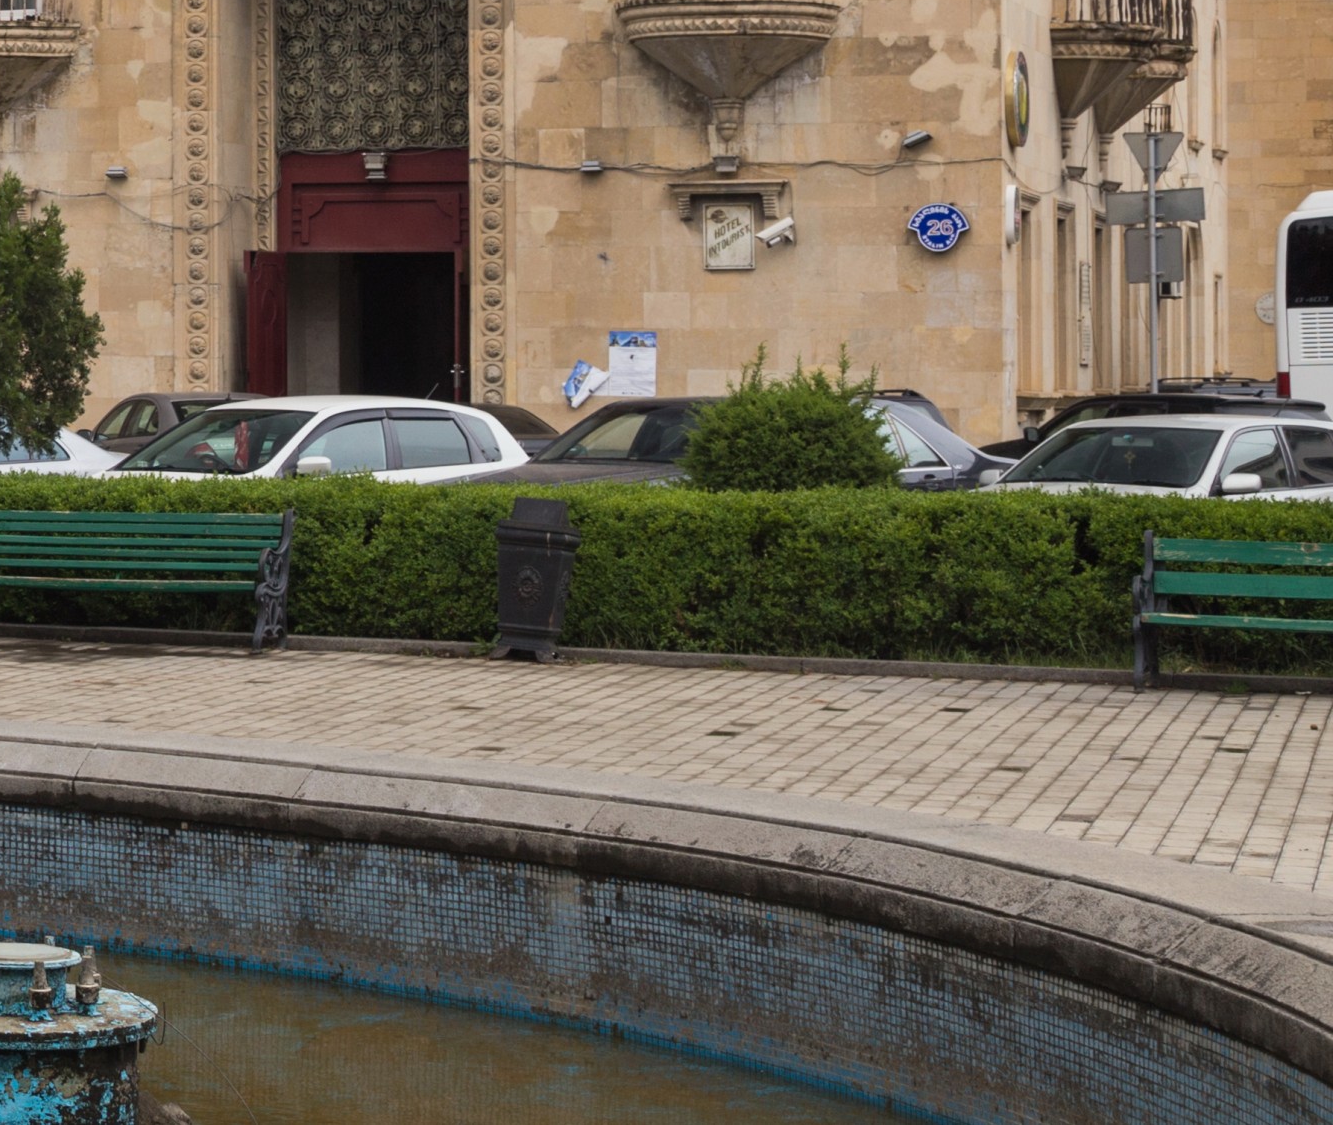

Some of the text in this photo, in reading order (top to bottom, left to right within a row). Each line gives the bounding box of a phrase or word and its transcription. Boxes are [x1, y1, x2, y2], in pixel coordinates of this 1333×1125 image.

[714, 217, 741, 240] HOTEL
[926, 219, 954, 236] 26
[708, 224, 750, 258] INTOURIST
